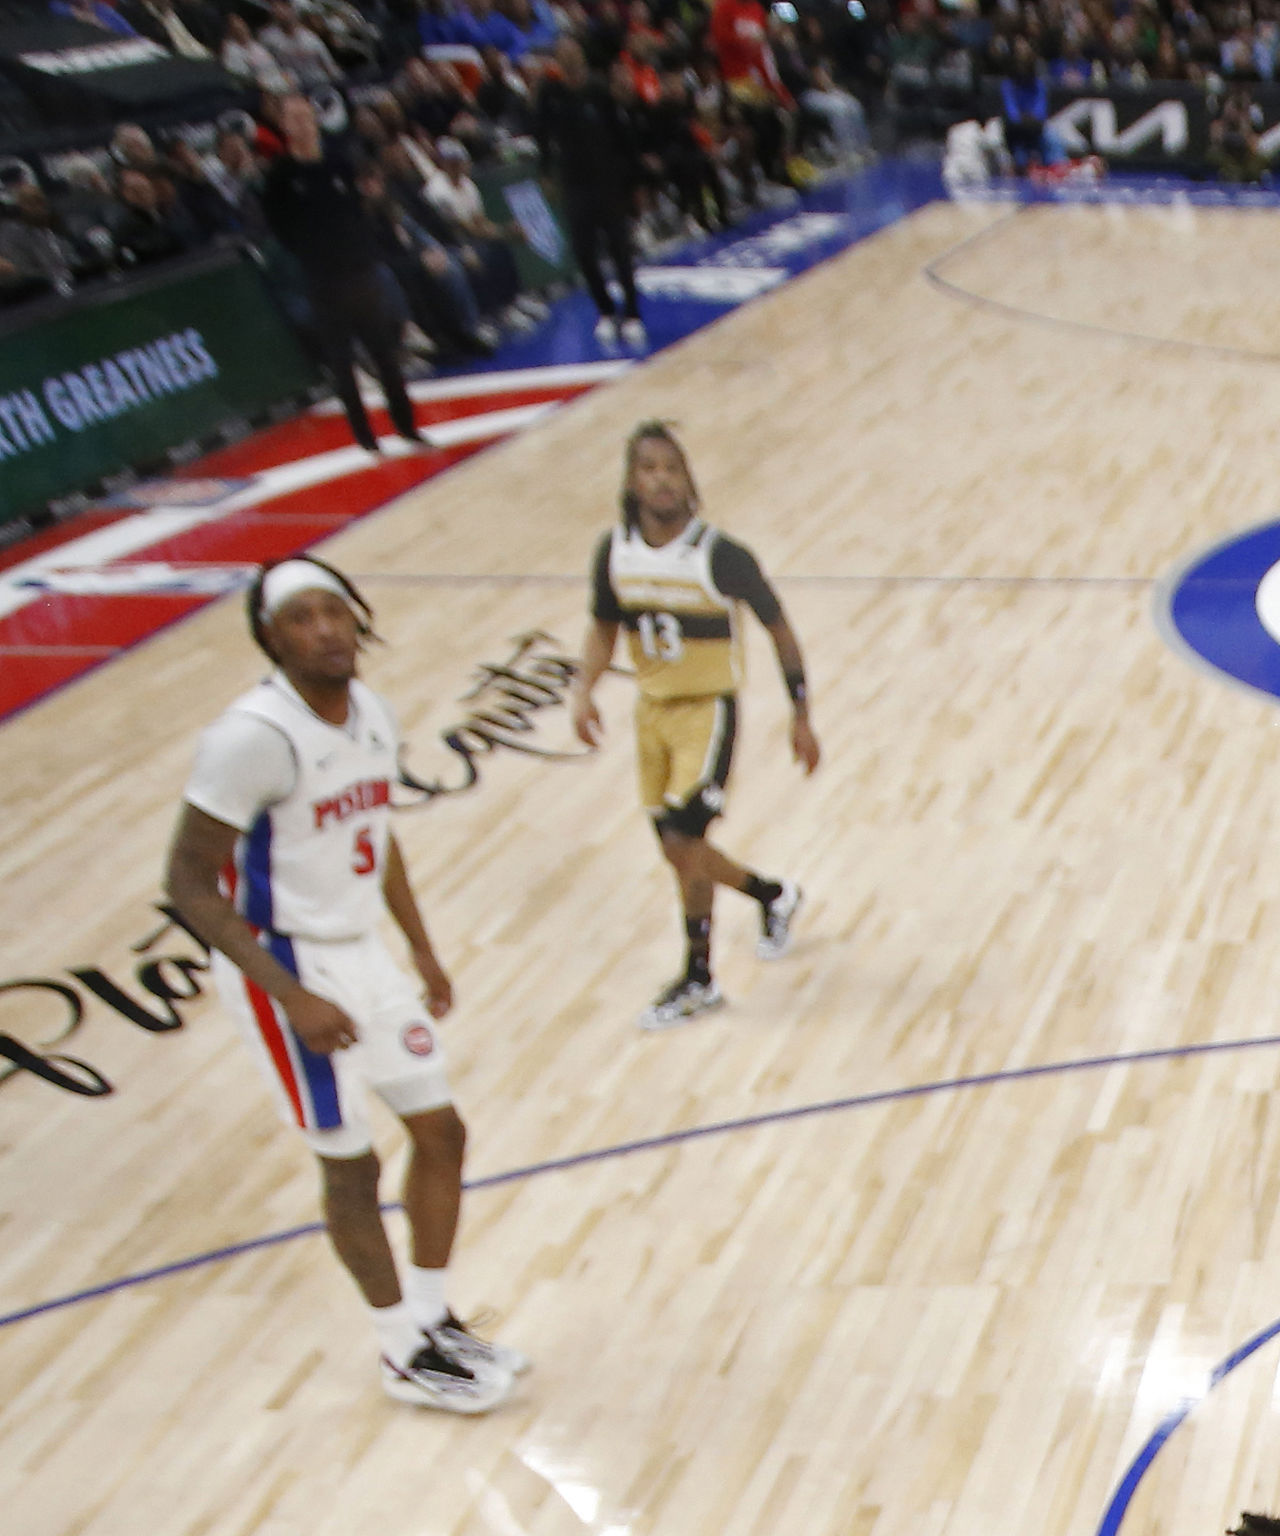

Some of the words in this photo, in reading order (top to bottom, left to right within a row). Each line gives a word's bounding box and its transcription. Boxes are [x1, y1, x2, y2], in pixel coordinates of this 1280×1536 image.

[42, 327, 220, 433] GREATNESS
[637, 612, 684, 661] 13
[352, 827, 376, 875] 5
